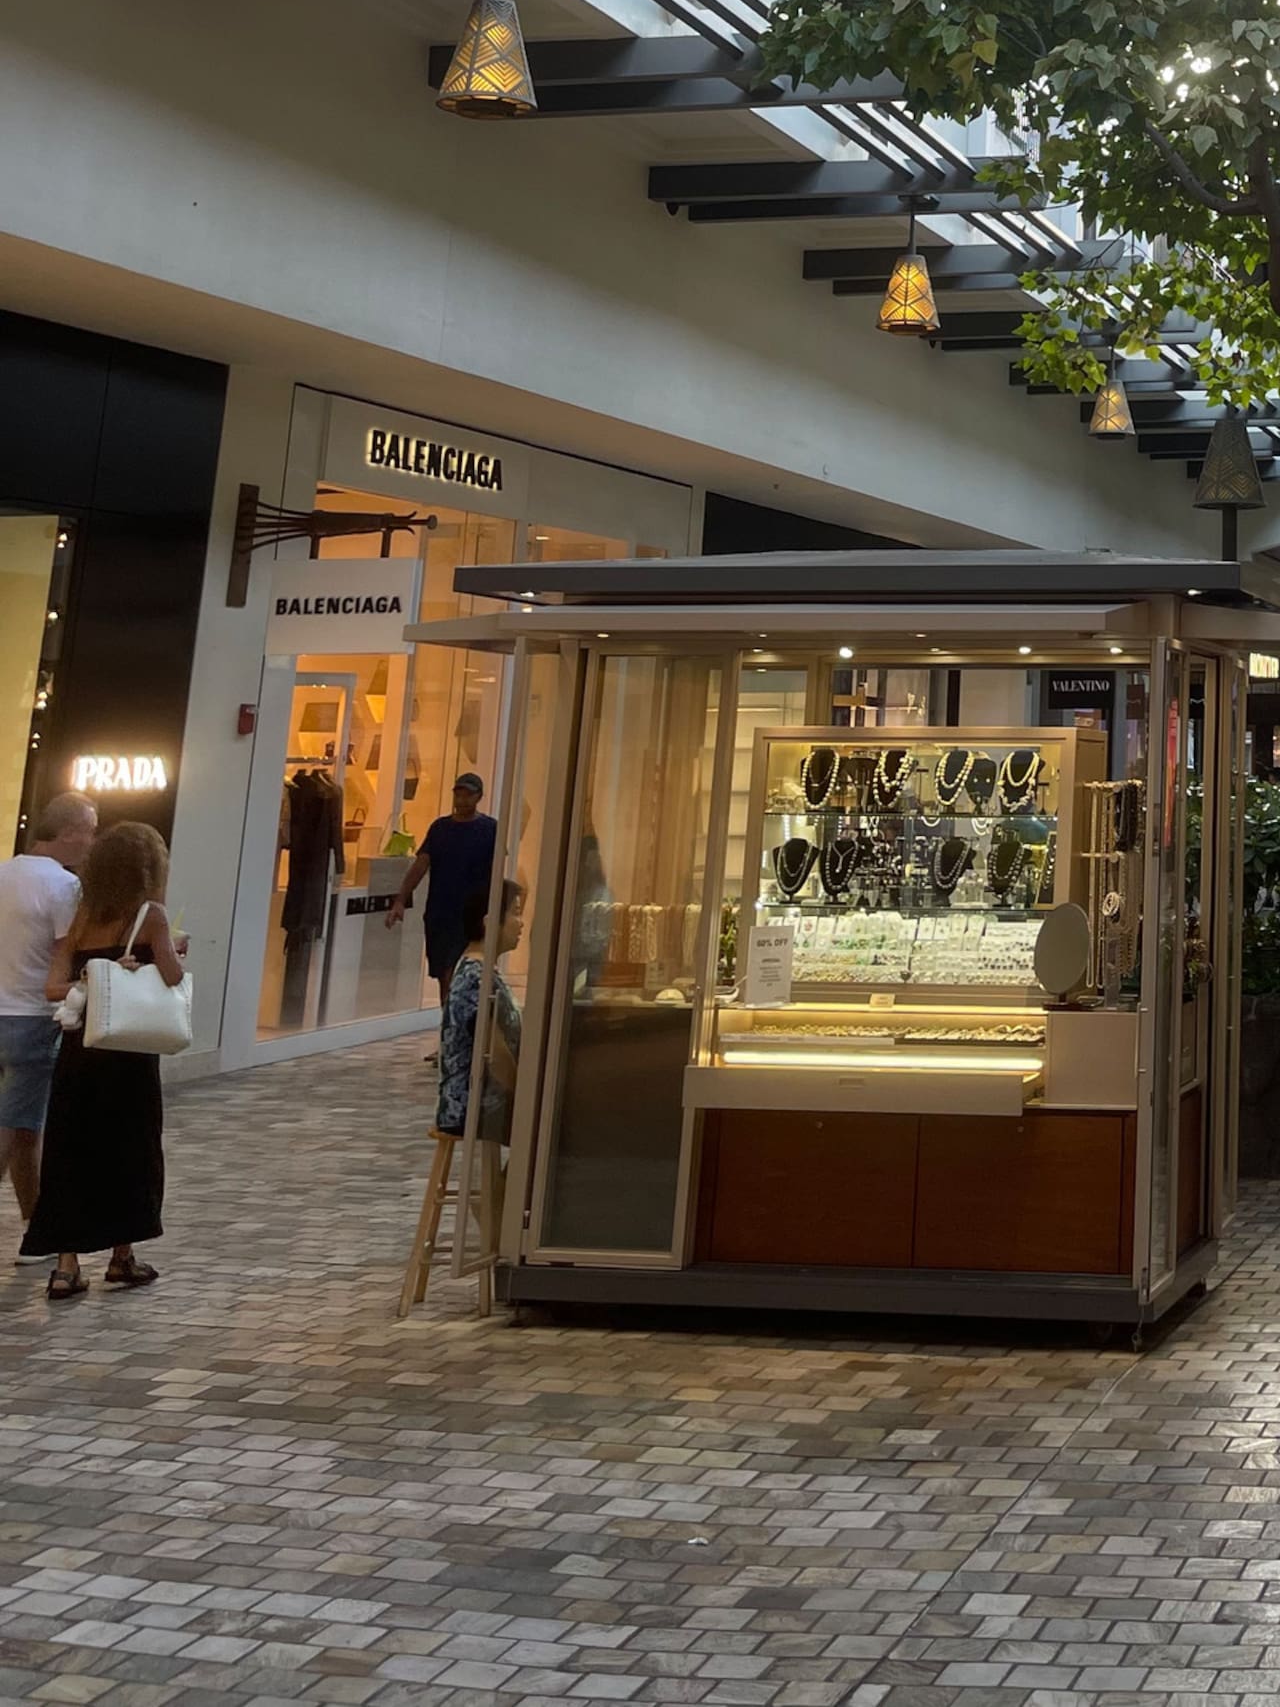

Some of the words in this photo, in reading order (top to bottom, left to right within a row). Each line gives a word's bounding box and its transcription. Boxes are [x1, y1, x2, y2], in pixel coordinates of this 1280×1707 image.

[370, 429, 503, 491] BALENCIAGA
[275, 596, 402, 615] BALENCIAGA
[1052, 680, 1110, 692] VALENTINO
[75, 756, 167, 791] PRADA
